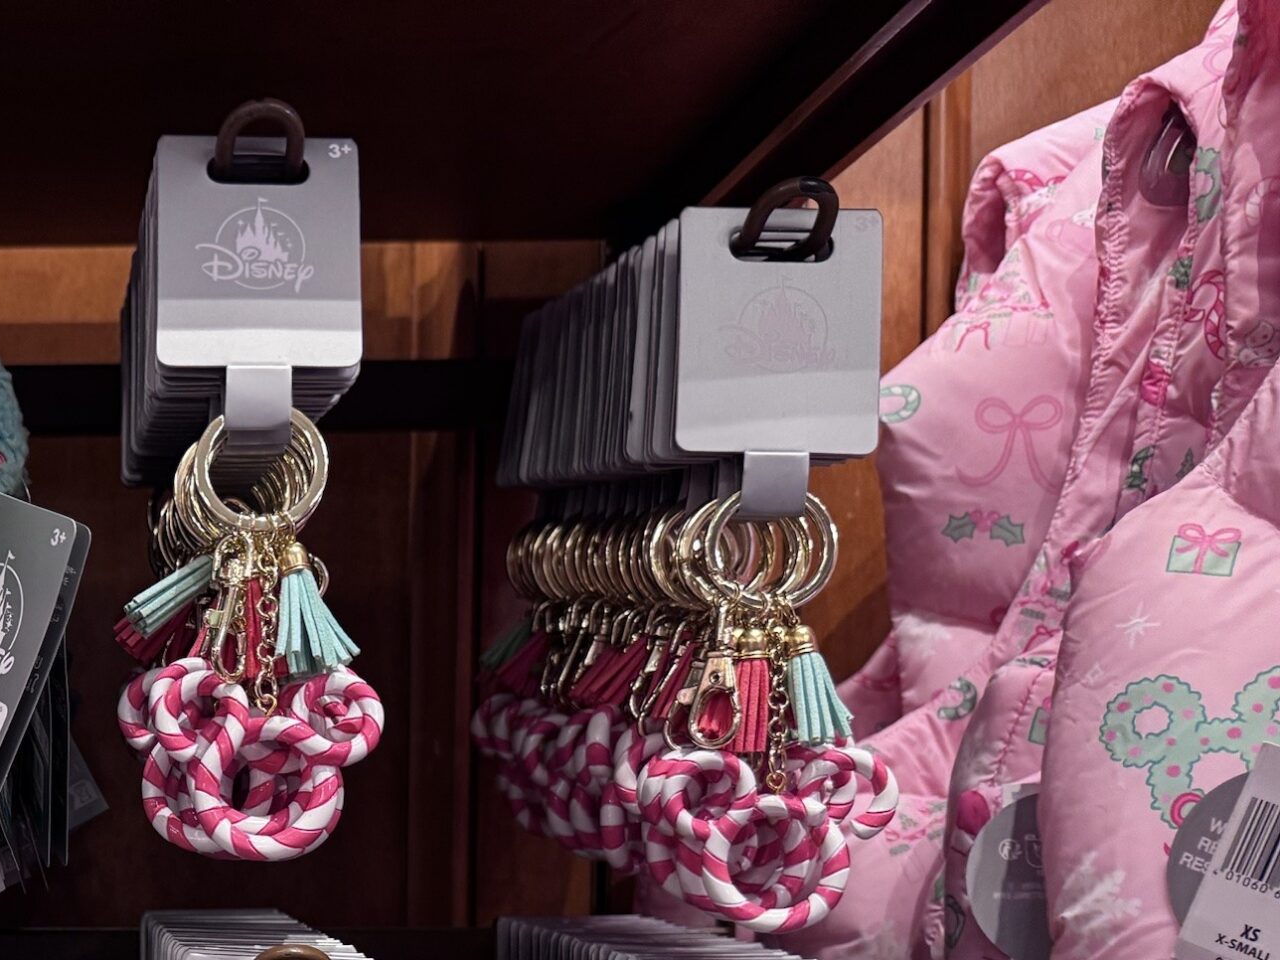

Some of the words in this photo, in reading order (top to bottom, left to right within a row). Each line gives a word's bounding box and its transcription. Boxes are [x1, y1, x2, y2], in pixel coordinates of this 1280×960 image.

[328, 143, 352, 158] 3+
[194, 243, 315, 293] Disney
[50, 528, 67, 546] 3+
[1240, 924, 1261, 942] XS
